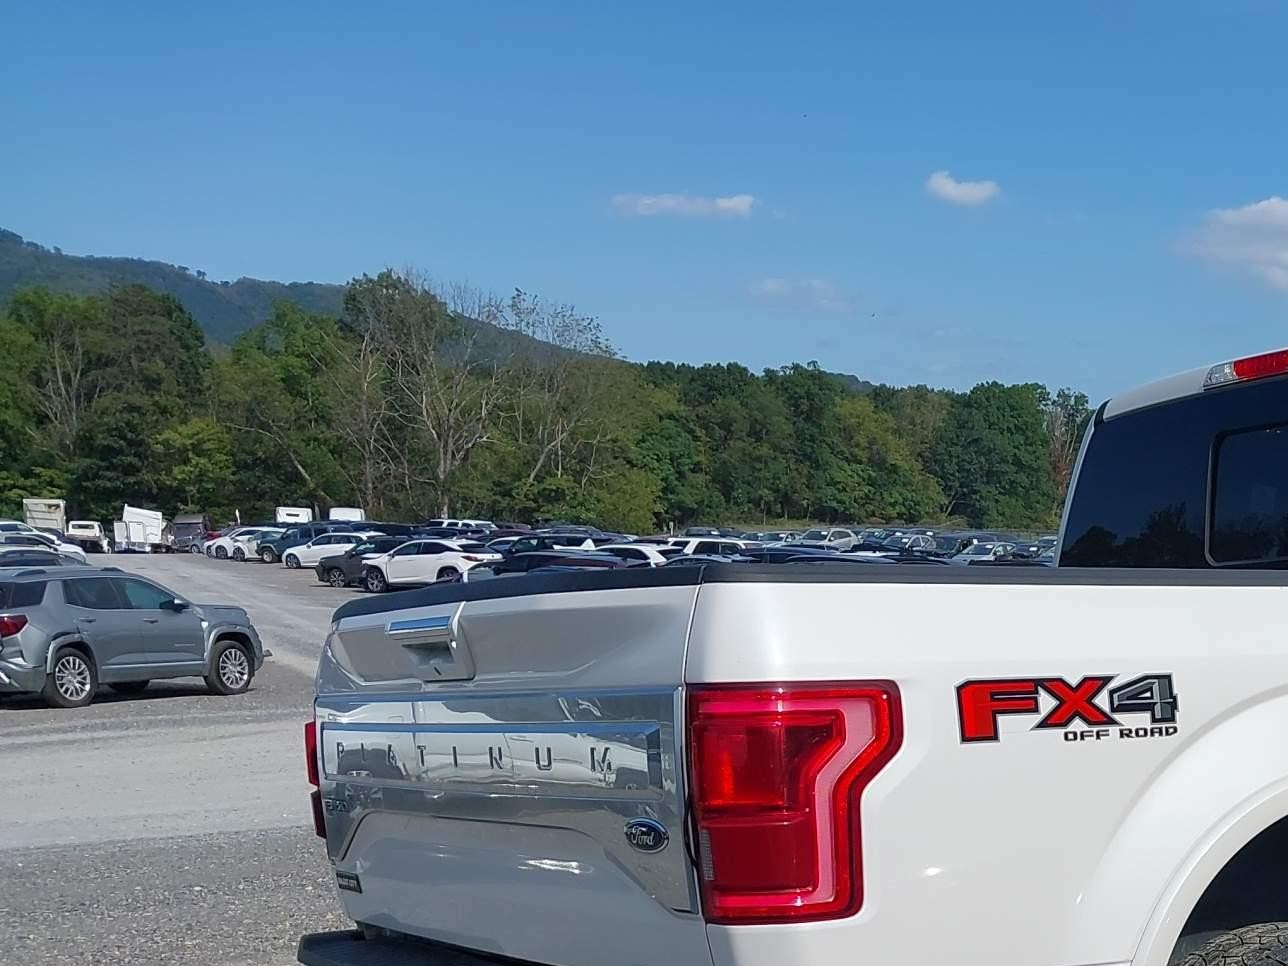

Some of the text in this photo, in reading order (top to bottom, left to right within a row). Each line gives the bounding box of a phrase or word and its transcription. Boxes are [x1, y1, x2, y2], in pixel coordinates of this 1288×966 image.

[955, 672, 1180, 744] FX4
[1063, 725, 1178, 742] OFF ROAD
[336, 741, 613, 774] PLATINUM
